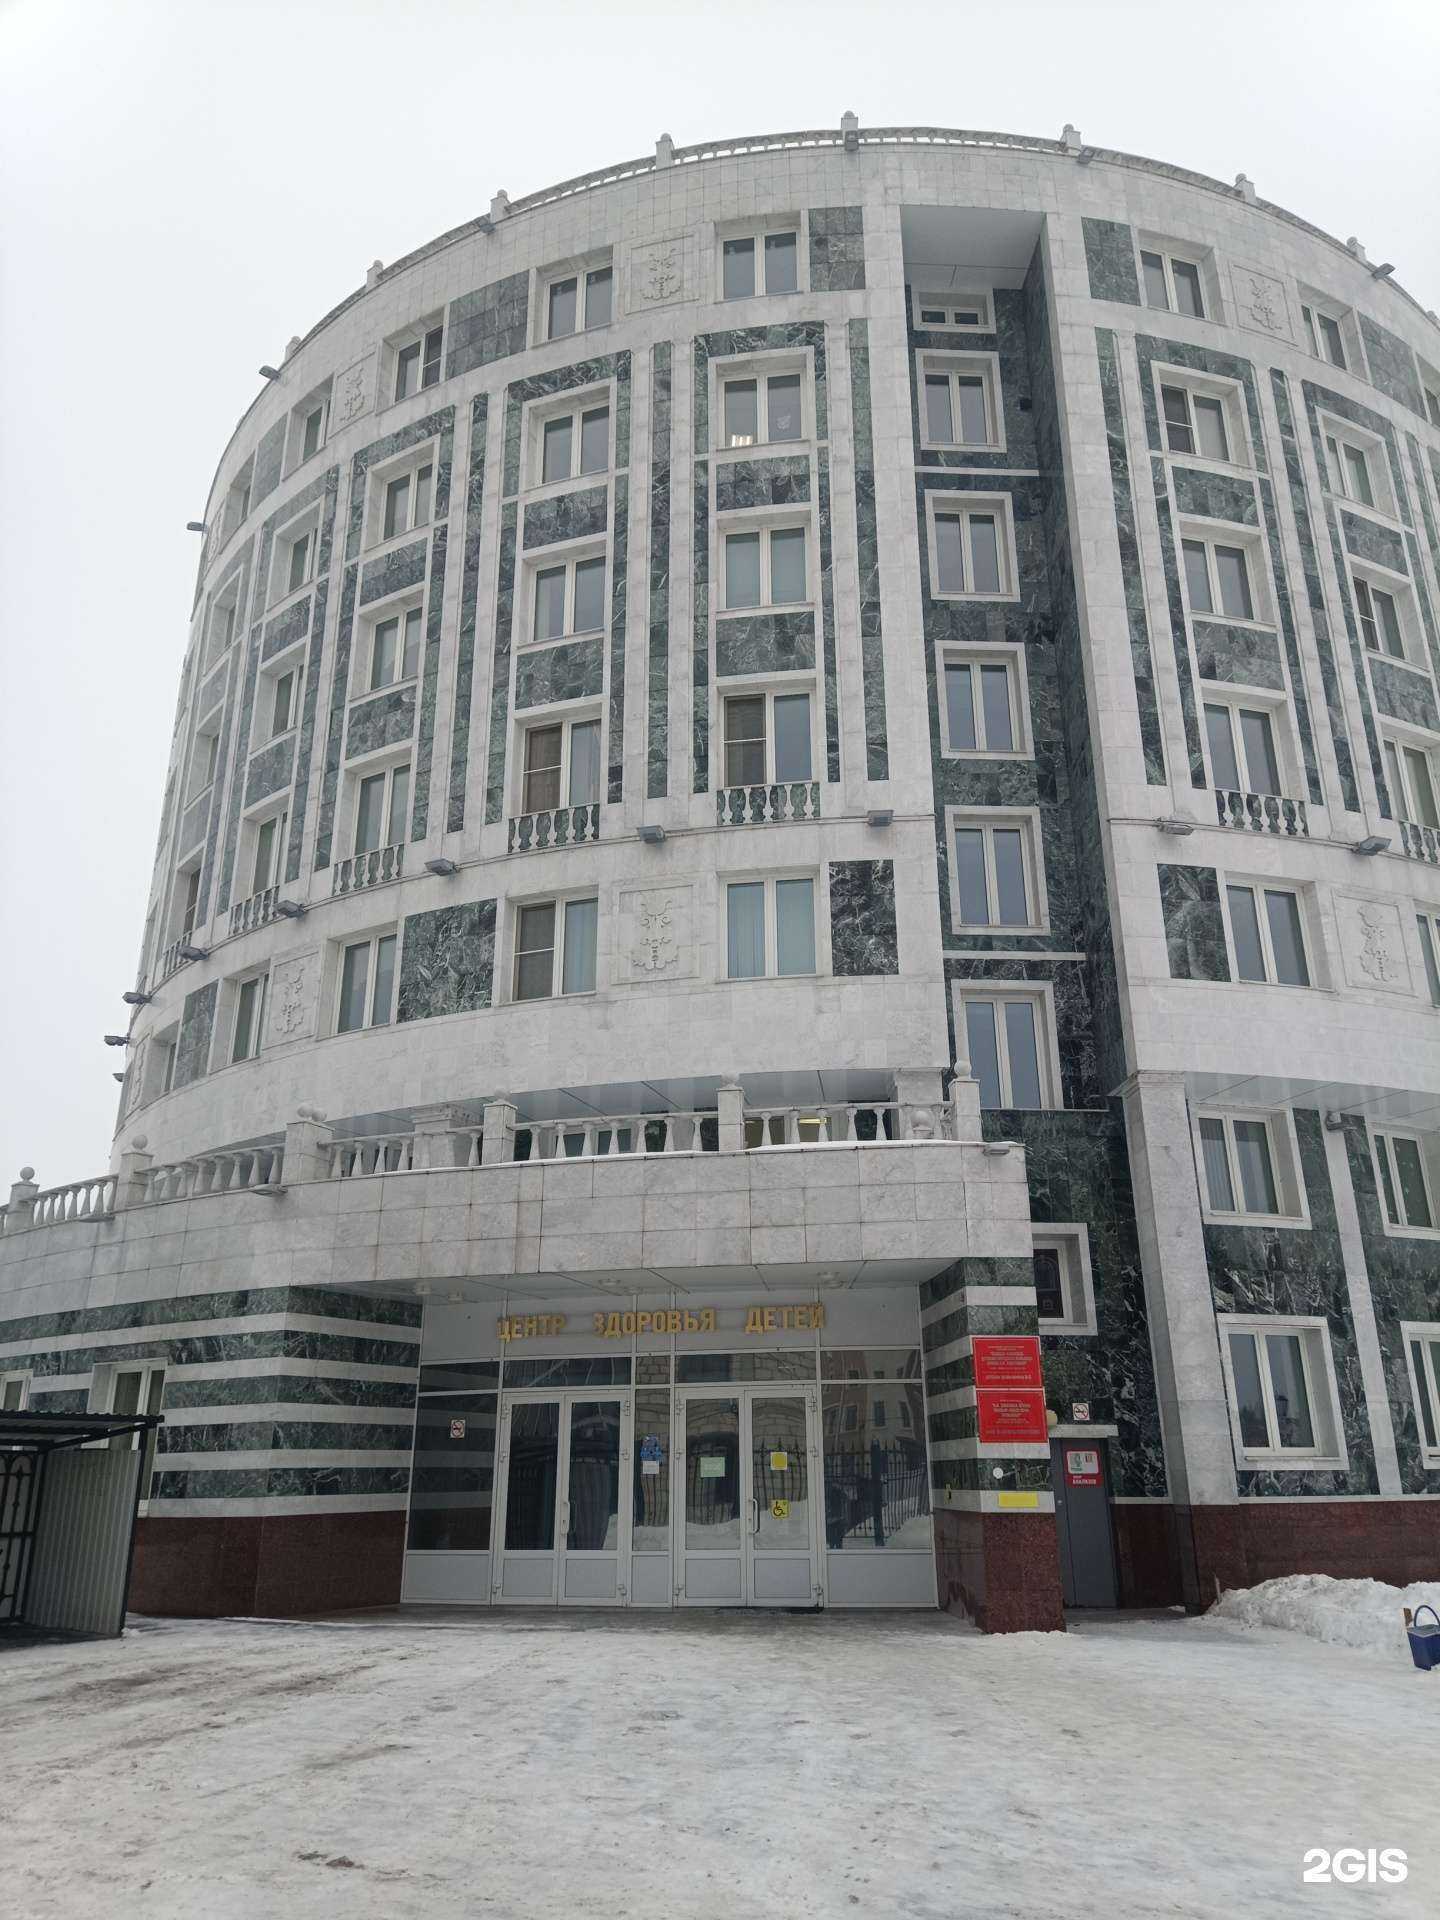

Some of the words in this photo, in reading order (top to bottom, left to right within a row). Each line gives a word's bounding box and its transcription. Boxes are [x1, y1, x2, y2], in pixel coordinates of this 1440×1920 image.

[496, 1313, 565, 1342] ЦЕНТР
[592, 1308, 717, 1337] ЗДОРОВЬЯ
[745, 1303, 825, 1334] ДЕТЕЙ
